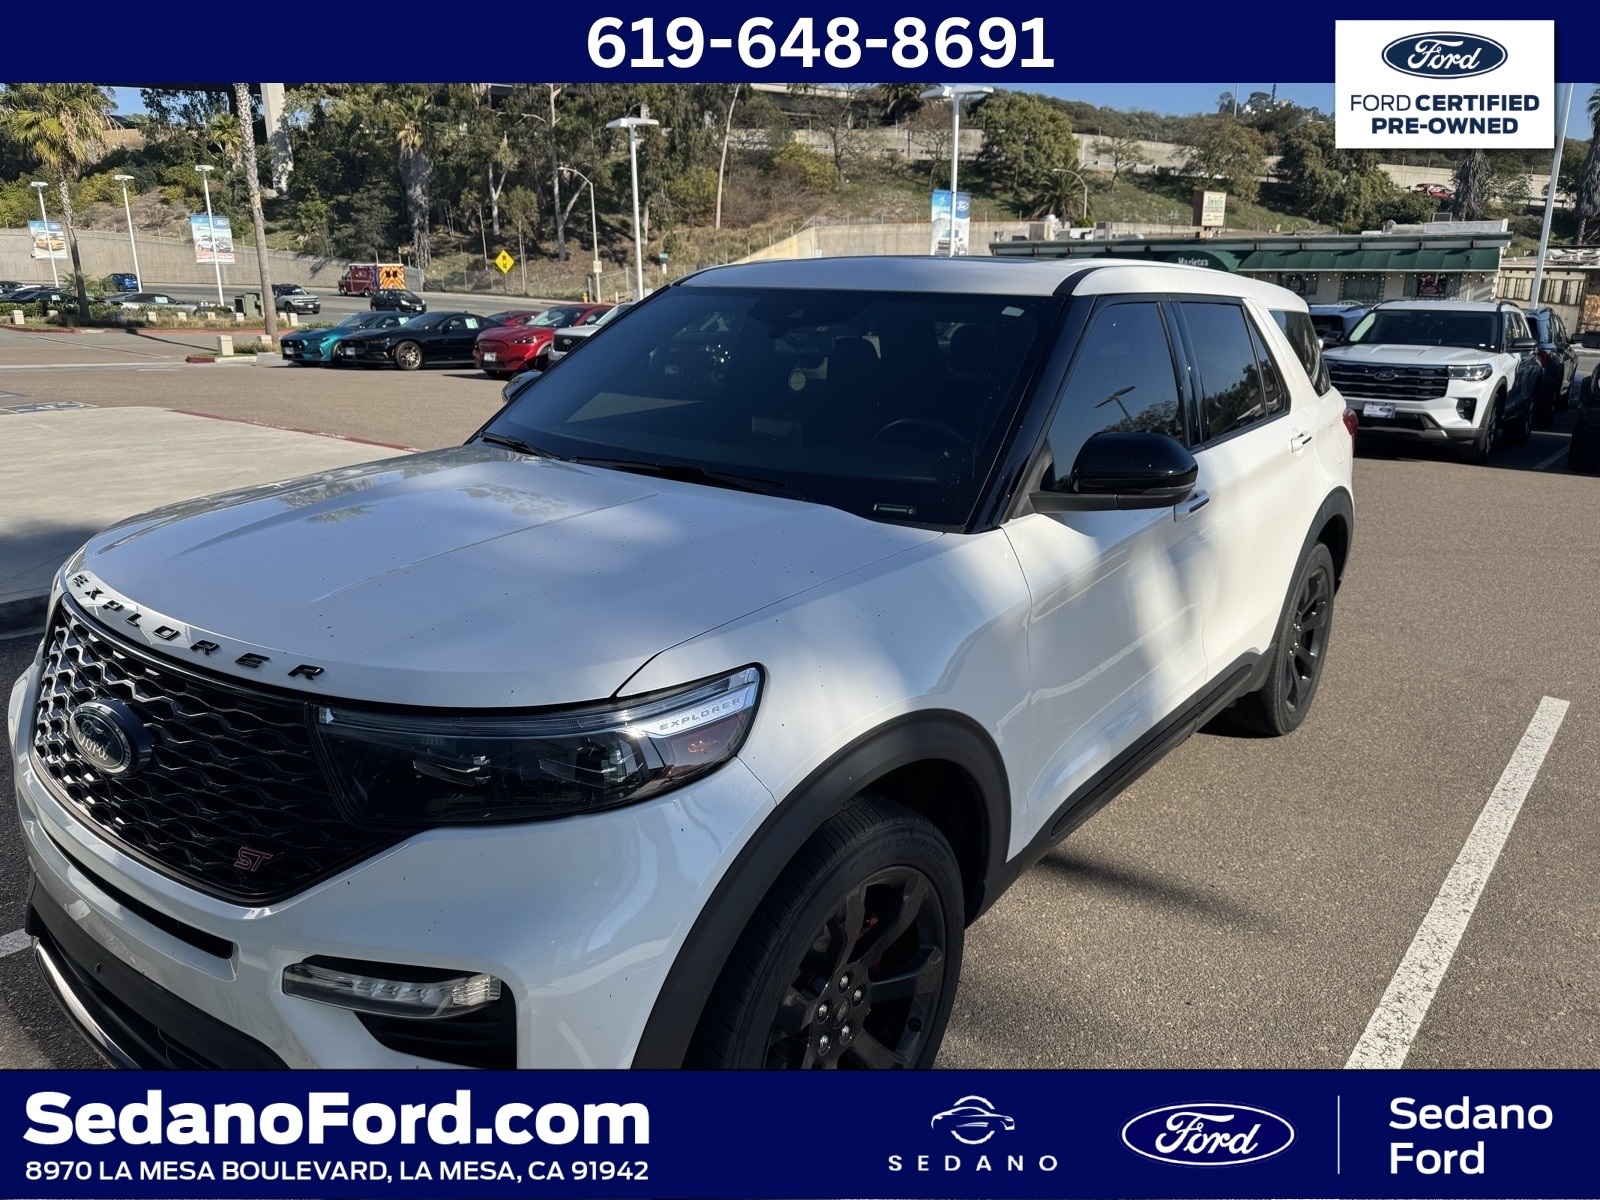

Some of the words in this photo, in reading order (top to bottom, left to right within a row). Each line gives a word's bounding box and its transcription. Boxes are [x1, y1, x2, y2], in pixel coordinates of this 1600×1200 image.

[73, 573, 326, 681] EXPLORER
[659, 698, 740, 731] EXPLORER
[78, 718, 111, 761] Ford
[233, 846, 273, 872] ST
